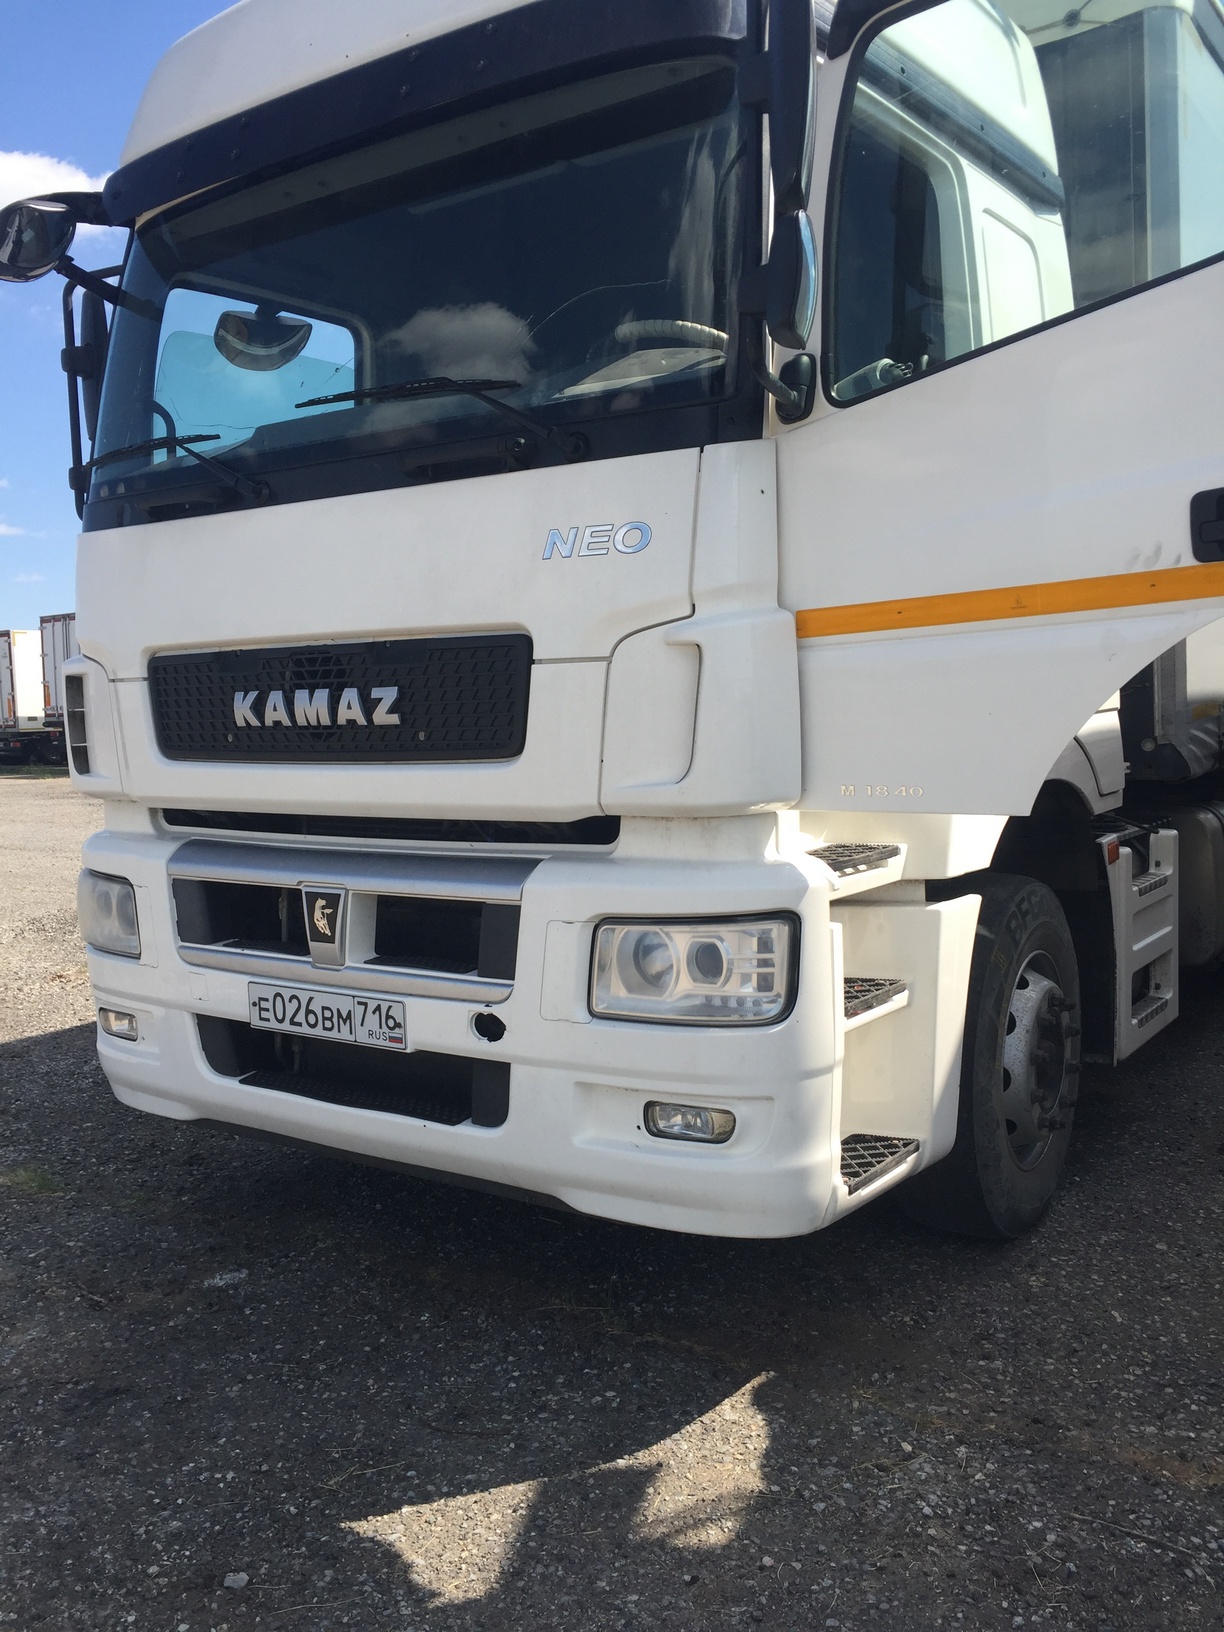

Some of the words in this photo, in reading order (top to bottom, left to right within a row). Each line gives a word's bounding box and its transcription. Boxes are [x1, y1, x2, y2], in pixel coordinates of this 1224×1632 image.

[541, 521, 653, 560] NEO
[233, 686, 401, 727] KAMAZ
[840, 784, 855, 797] M
[356, 1000, 398, 1031] 716
[368, 1029, 388, 1042] RUS
